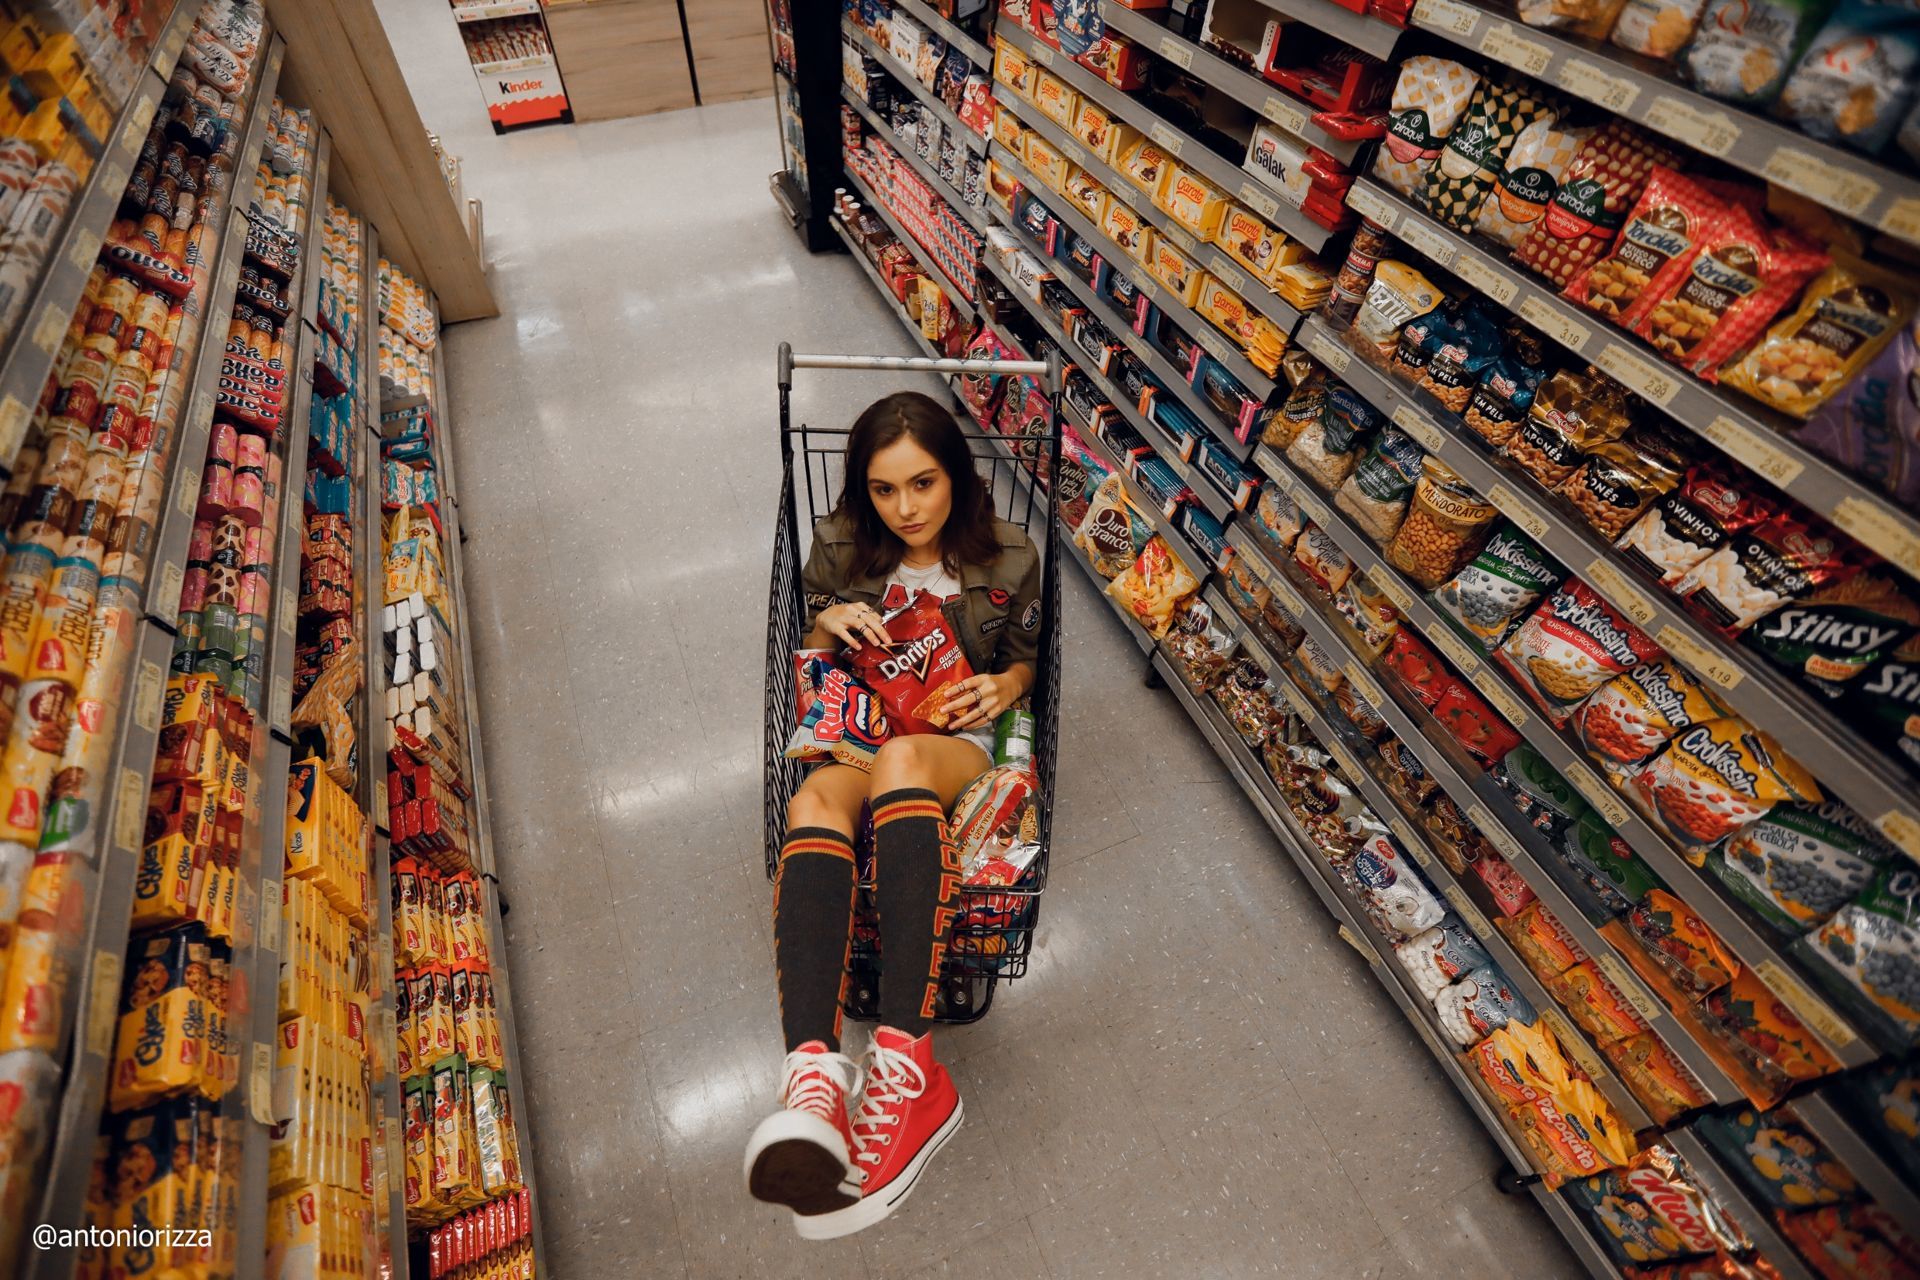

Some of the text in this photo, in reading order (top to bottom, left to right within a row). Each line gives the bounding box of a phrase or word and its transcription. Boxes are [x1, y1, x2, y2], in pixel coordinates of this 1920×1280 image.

[499, 79, 544, 95] kinder
[1393, 120, 1425, 142] piraquê
[942, 144, 955, 161] BIS
[940, 163, 953, 181] BIS
[1255, 146, 1286, 183] Galak
[1177, 176, 1205, 204] Garoto
[1508, 178, 1550, 201] piraquê
[1557, 190, 1596, 217] piraquê
[1112, 208, 1134, 231] Garoto
[1231, 213, 1260, 239] Garoto
[1549, 212, 1580, 233] queijinho
[1627, 218, 1689, 257] Torcida
[1159, 247, 1182, 274] Garoto
[1435, 247, 1451, 264] 3,19
[1619, 248, 1654, 270] BOTECO
[1694, 256, 1759, 296] Torcida
[1491, 282, 1509, 301] 3,19
[1686, 286, 1722, 310] BOTECO
[1213, 290, 1242, 320] Garoto
[1560, 328, 1580, 346] 3,19
[1404, 350, 1422, 367] PELE
[1438, 369, 1459, 386] PELE
[1643, 380, 1668, 400] 2,99
[1486, 402, 1504, 421] PELE
[1420, 484, 1487, 520] MENDORATO
[1095, 508, 1130, 537] Ouro
[1667, 499, 1720, 543] OVINHOS
[1087, 523, 1130, 553] Branco
[1748, 544, 1805, 591] OVINHOS
[1628, 602, 1648, 622] 4,49
[1762, 610, 1899, 653] Stiksy
[878, 627, 946, 681] Doritos
[1573, 632, 1608, 660] CROCANTE
[1708, 665, 1731, 684] 4,19
[1759, 834, 1796, 853] CEBOLA
[1768, 825, 1800, 844] SALSA
[1447, 949, 1466, 967] COCO
[1536, 1096, 1596, 1170] Paçoquita
